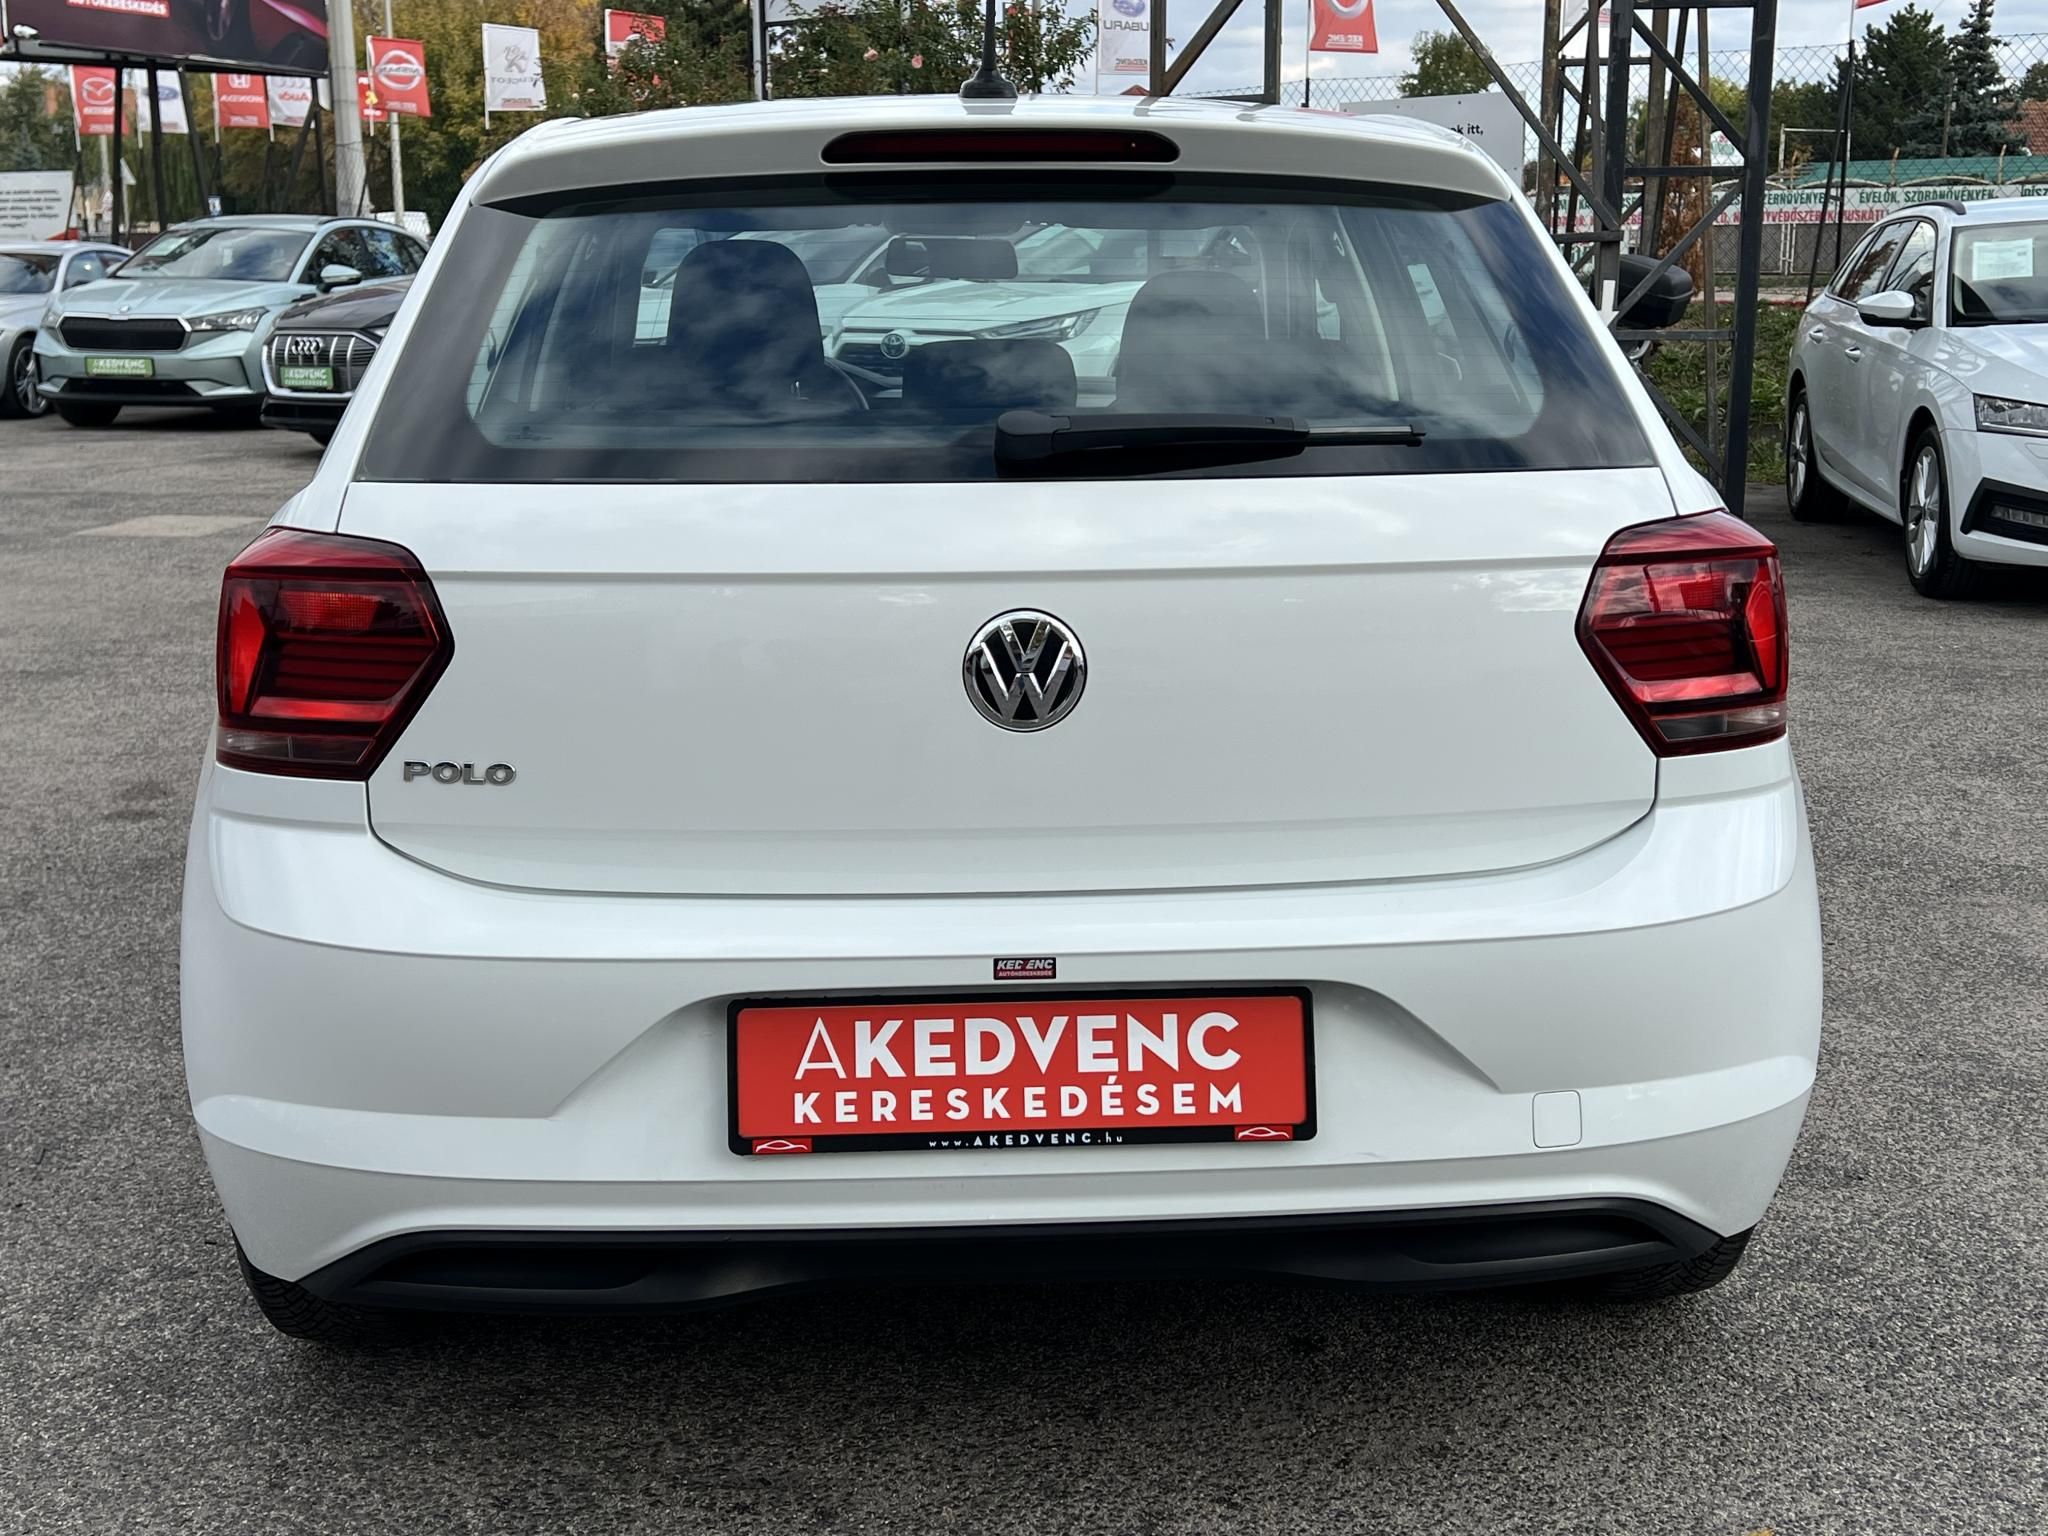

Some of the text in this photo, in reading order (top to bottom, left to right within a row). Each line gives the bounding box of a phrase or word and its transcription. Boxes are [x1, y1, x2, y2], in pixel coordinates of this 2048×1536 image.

[1467, 123, 1484, 136] itt,
[403, 760, 517, 786] POLO
[794, 1011, 1242, 1080] AKEDVENC
[794, 1075, 1243, 1124] KERESKEDÉSEM
[928, 1131, 1123, 1148] www.AKEDVENC.hu
